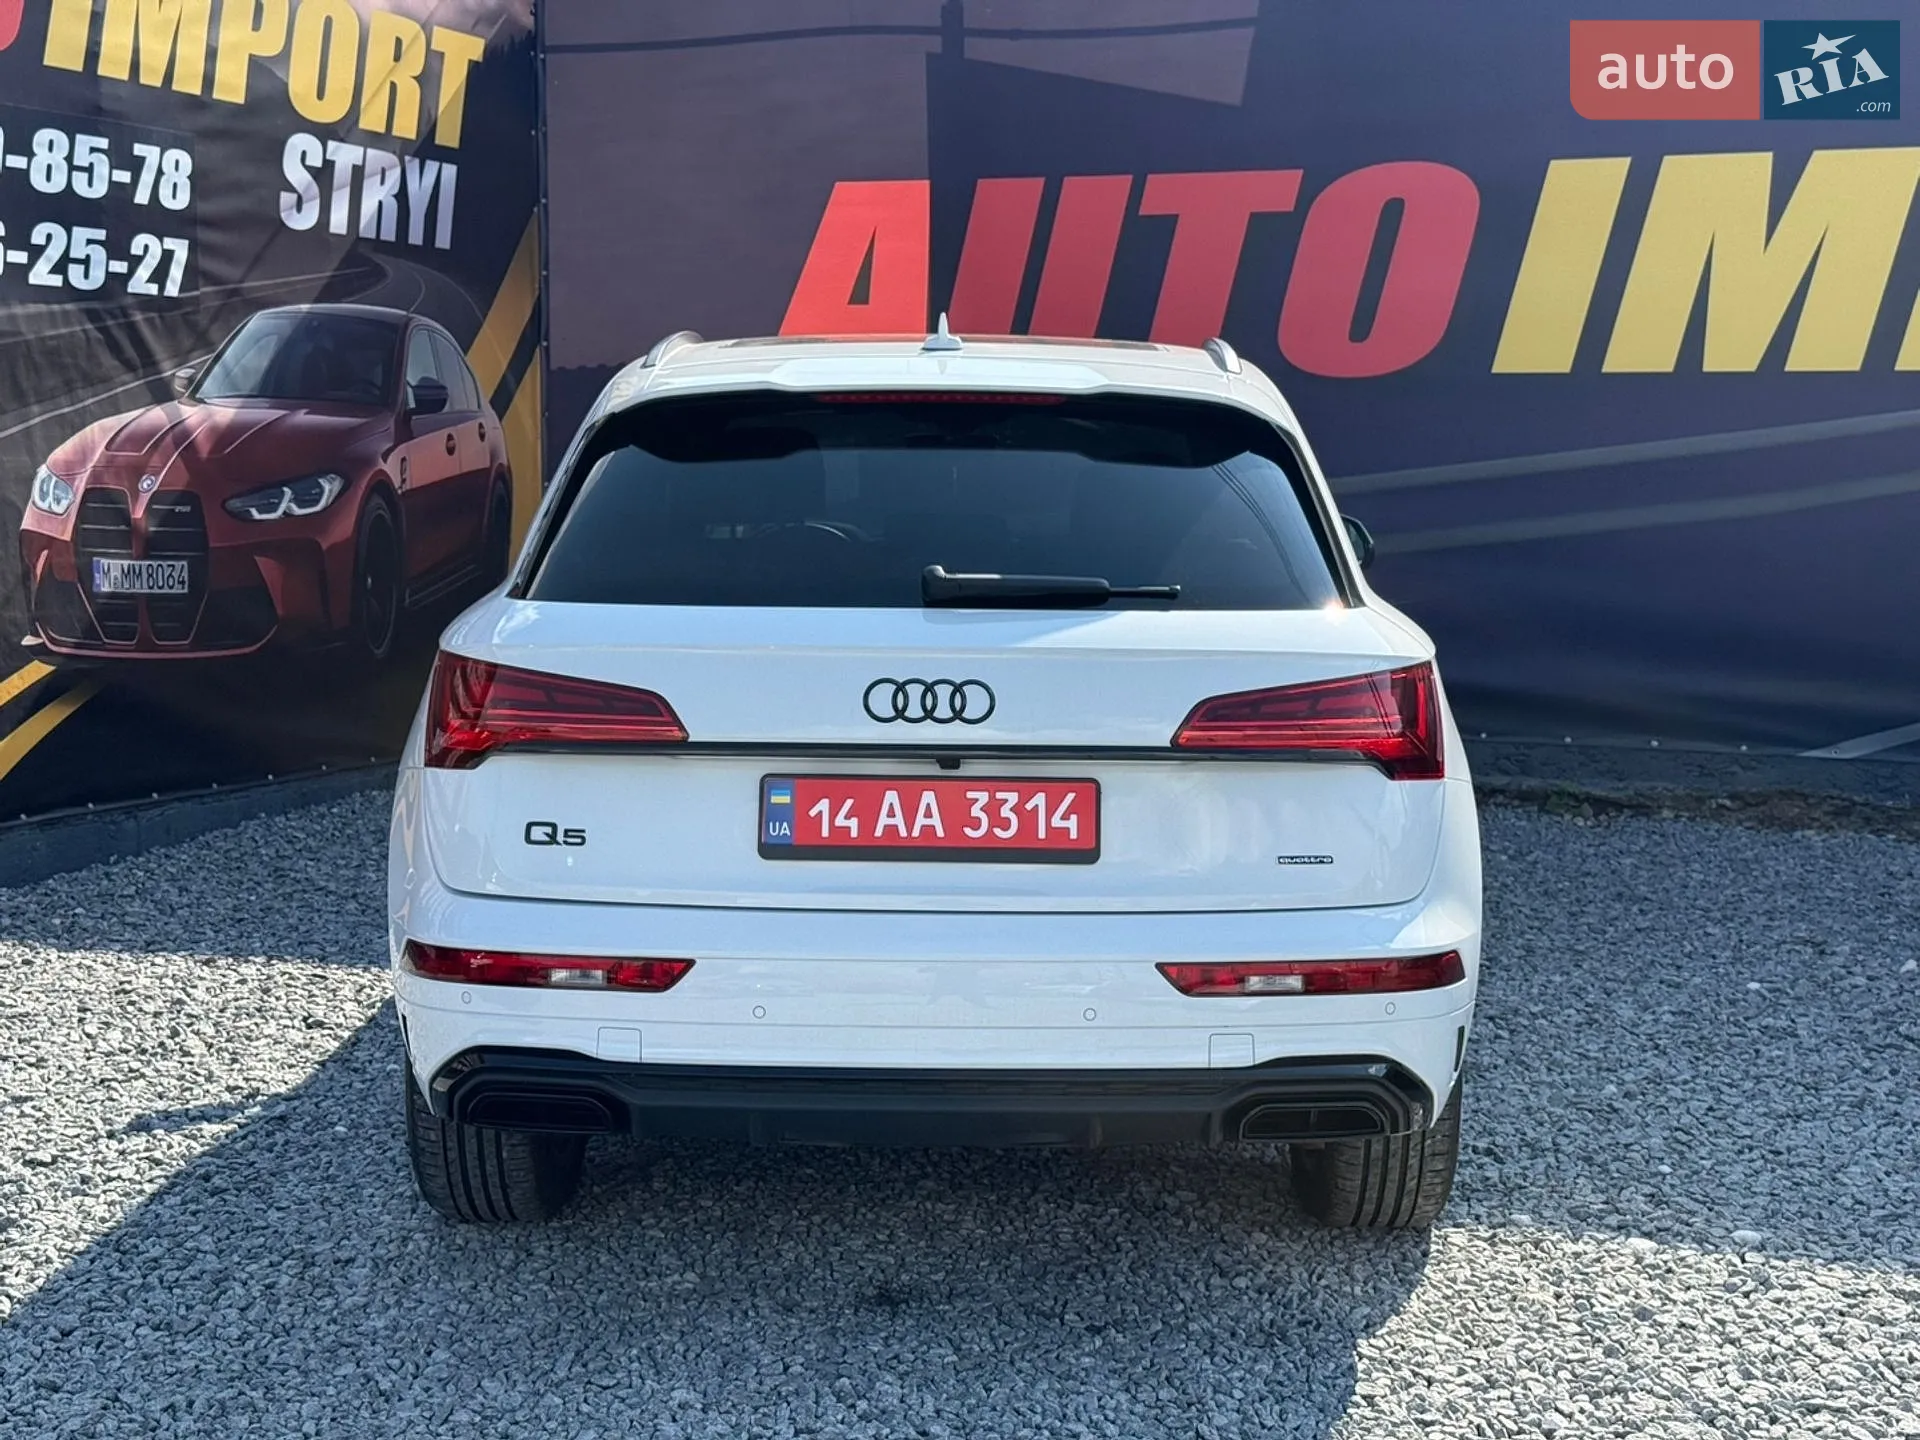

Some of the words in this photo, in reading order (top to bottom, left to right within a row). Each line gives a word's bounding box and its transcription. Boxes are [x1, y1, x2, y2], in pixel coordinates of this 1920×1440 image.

[43, 0, 485, 149] IMPORT
[0, 125, 193, 211] -85-78
[278, 132, 458, 250] STRYI
[0, 220, 190, 298] -25-27
[778, 160, 1481, 379] AUTO
[1491, 147, 1920, 373] IM
[524, 821, 587, 847] Q5
[769, 821, 791, 837] UA
[808, 798, 860, 839] 14
[873, 789, 946, 839] AA
[962, 790, 1080, 840] 3314
[1278, 855, 1333, 865] quattro
